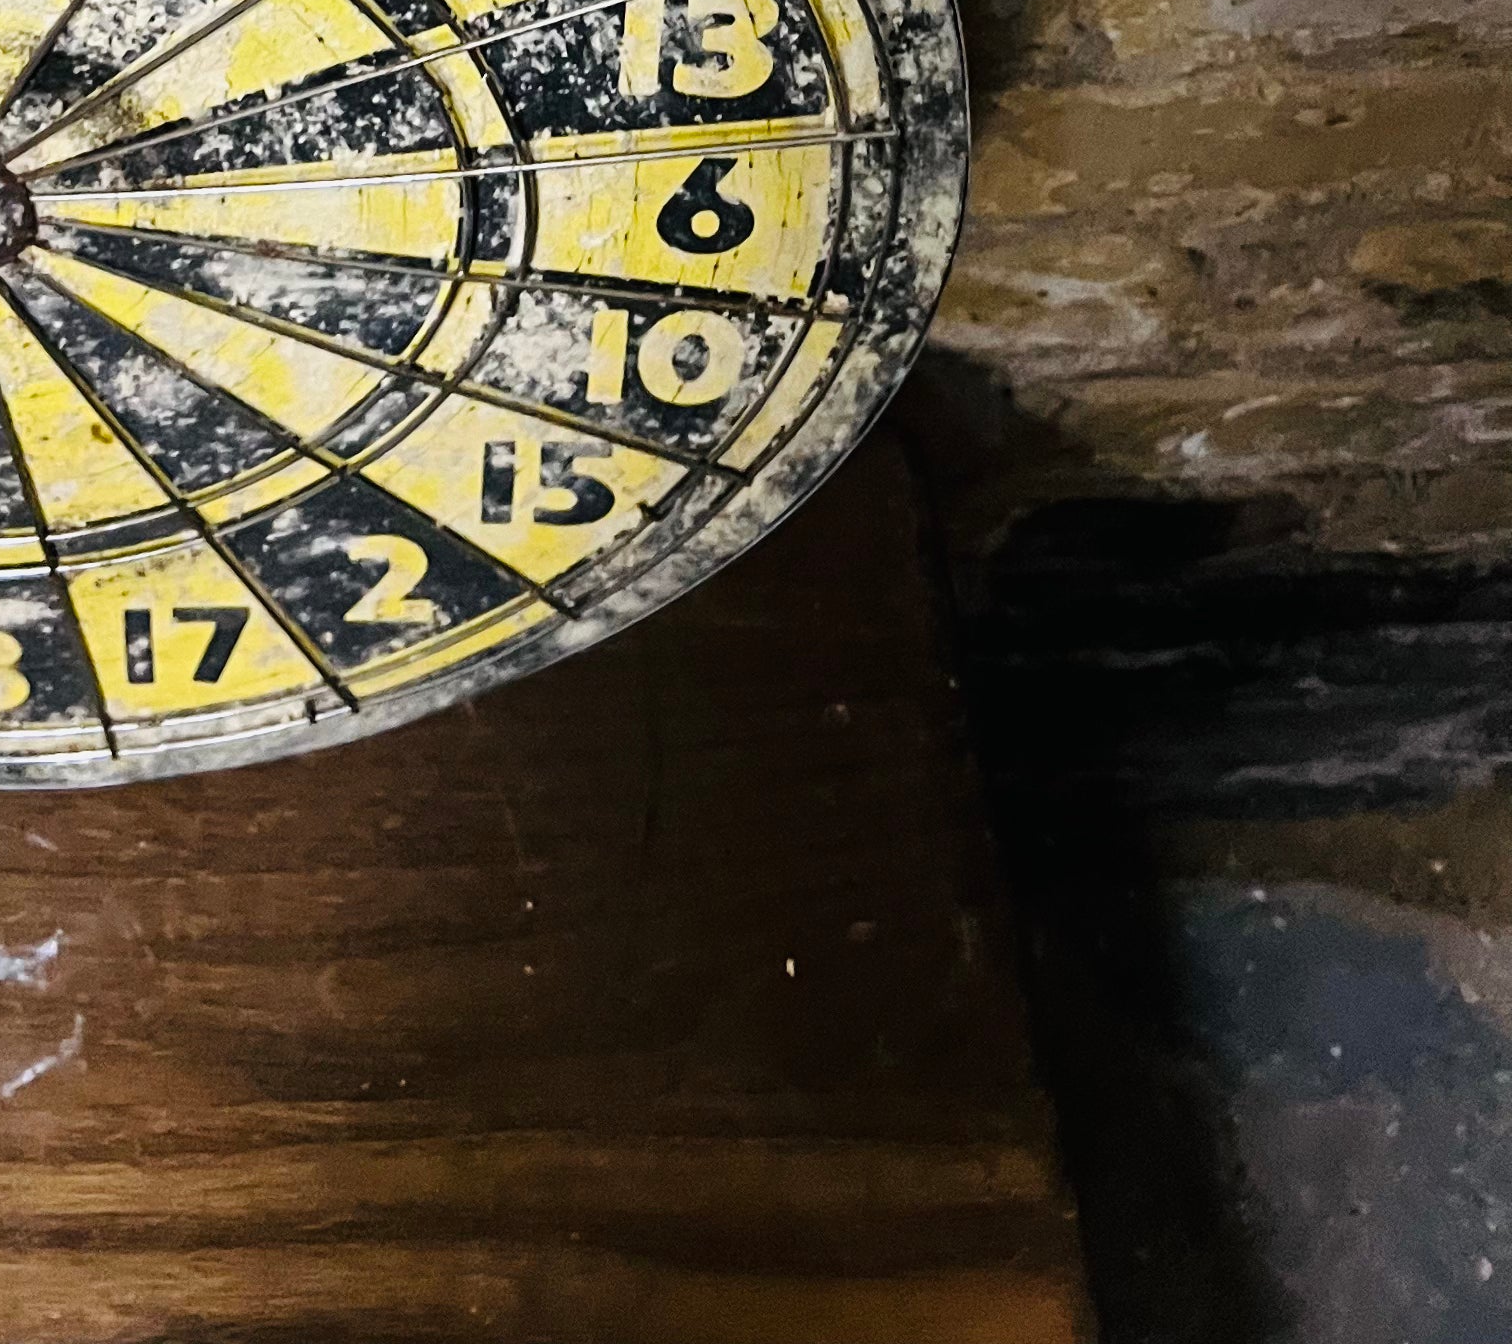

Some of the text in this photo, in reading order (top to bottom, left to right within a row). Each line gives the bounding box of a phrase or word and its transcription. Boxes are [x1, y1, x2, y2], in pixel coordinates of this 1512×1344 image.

[655, 157, 756, 253] 6
[586, 310, 745, 405] 10
[481, 441, 615, 526] 15
[342, 534, 434, 624] 2
[123, 606, 251, 683] 17
